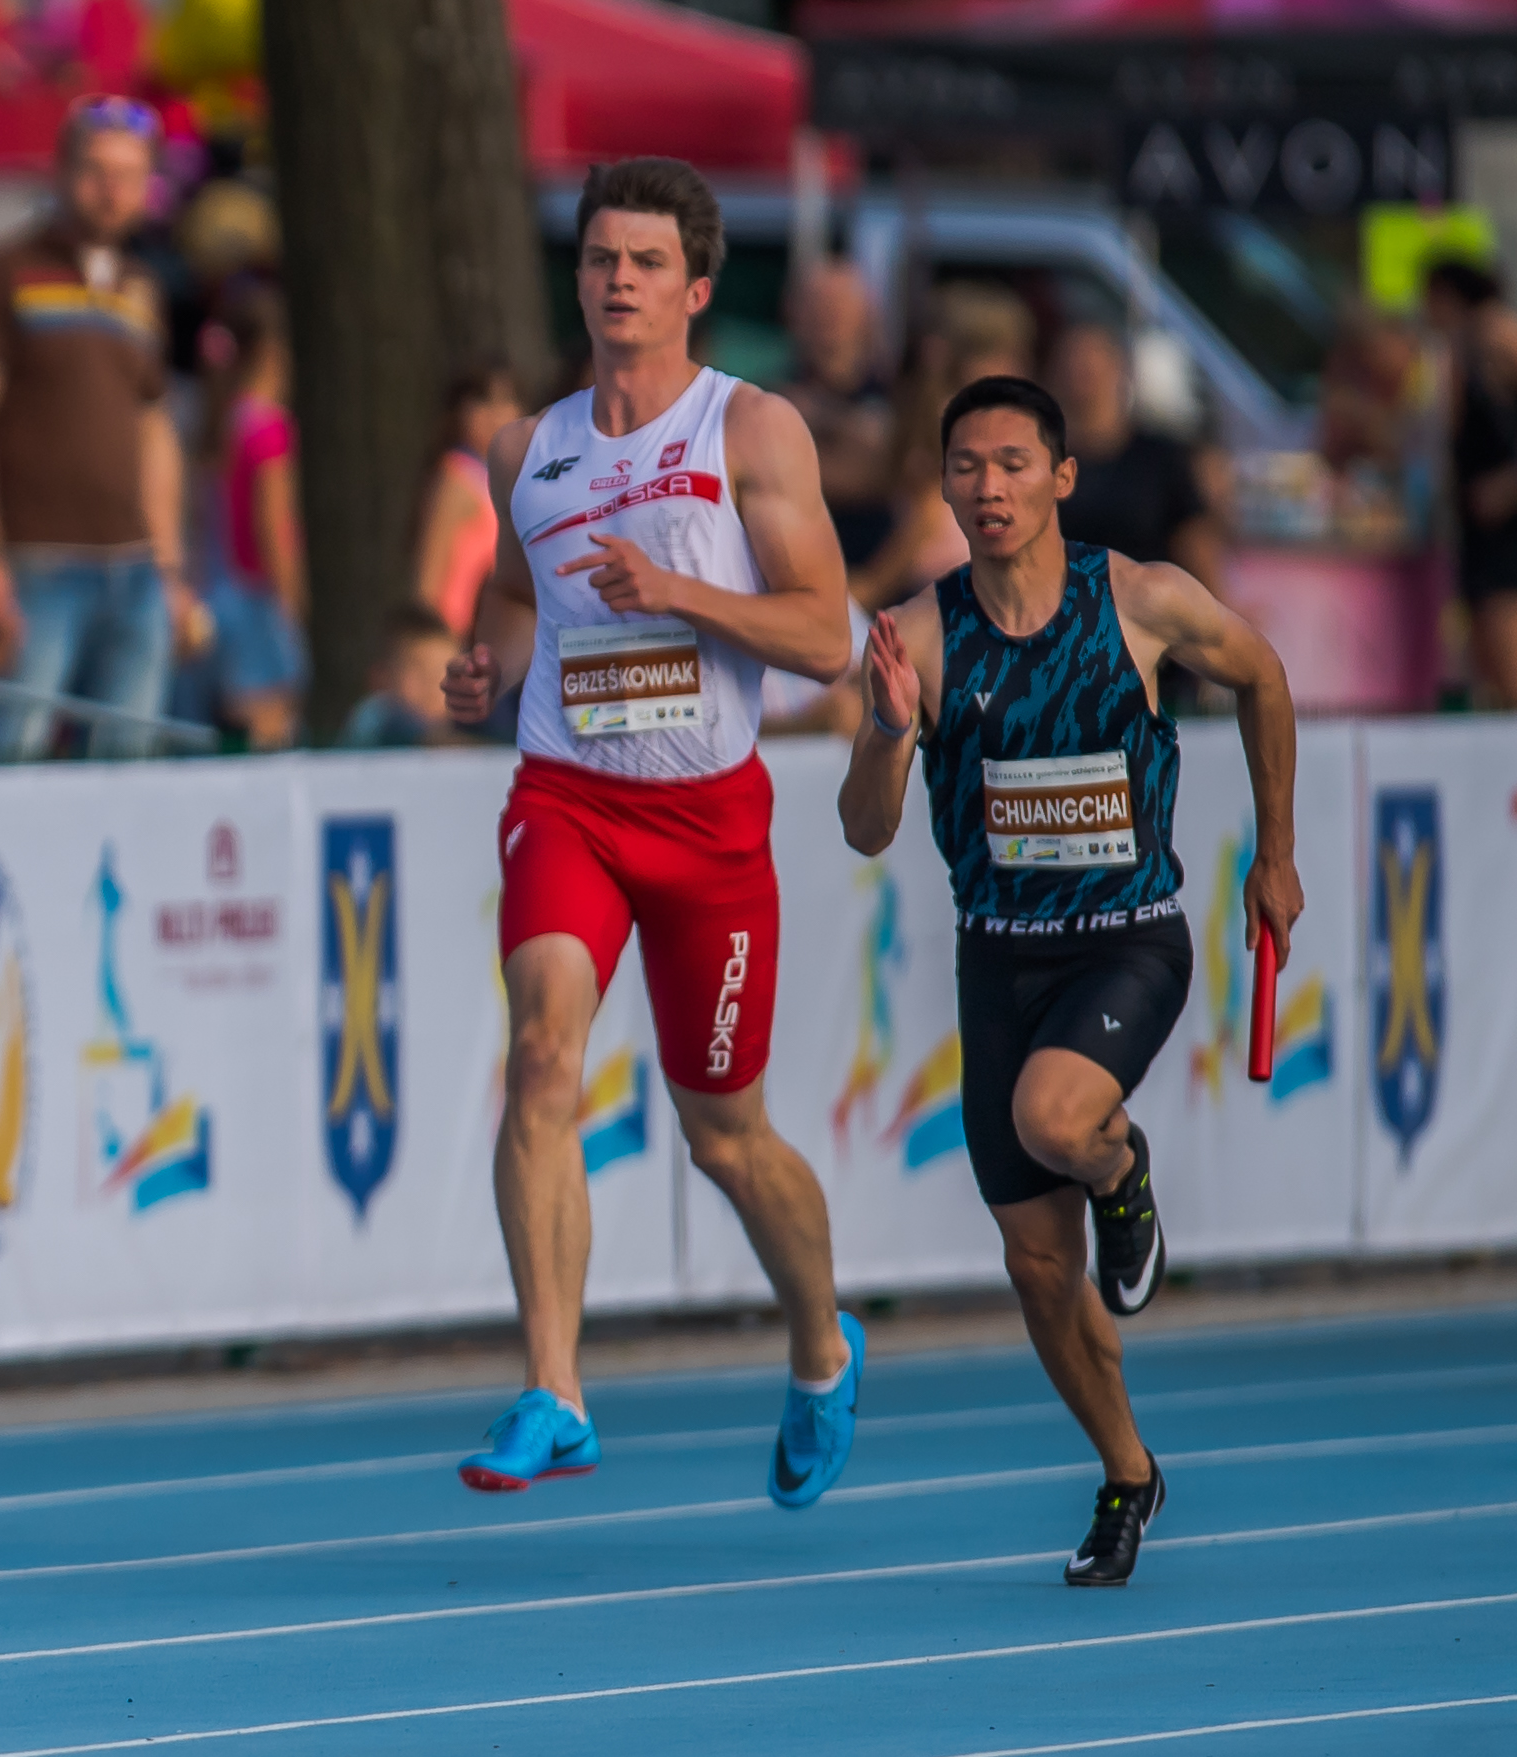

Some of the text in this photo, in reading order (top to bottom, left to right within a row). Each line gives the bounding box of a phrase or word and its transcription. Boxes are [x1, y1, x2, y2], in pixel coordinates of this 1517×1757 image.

[1127, 119, 1445, 209] AVON
[531, 455, 581, 480] 4F
[585, 475, 692, 521] POLSKA
[563, 661, 696, 695] GRZEŚKOWIAK
[991, 791, 1127, 825] CHUANGCHAI
[985, 916, 1064, 934] WEAR
[706, 930, 750, 1077] POLSKA
